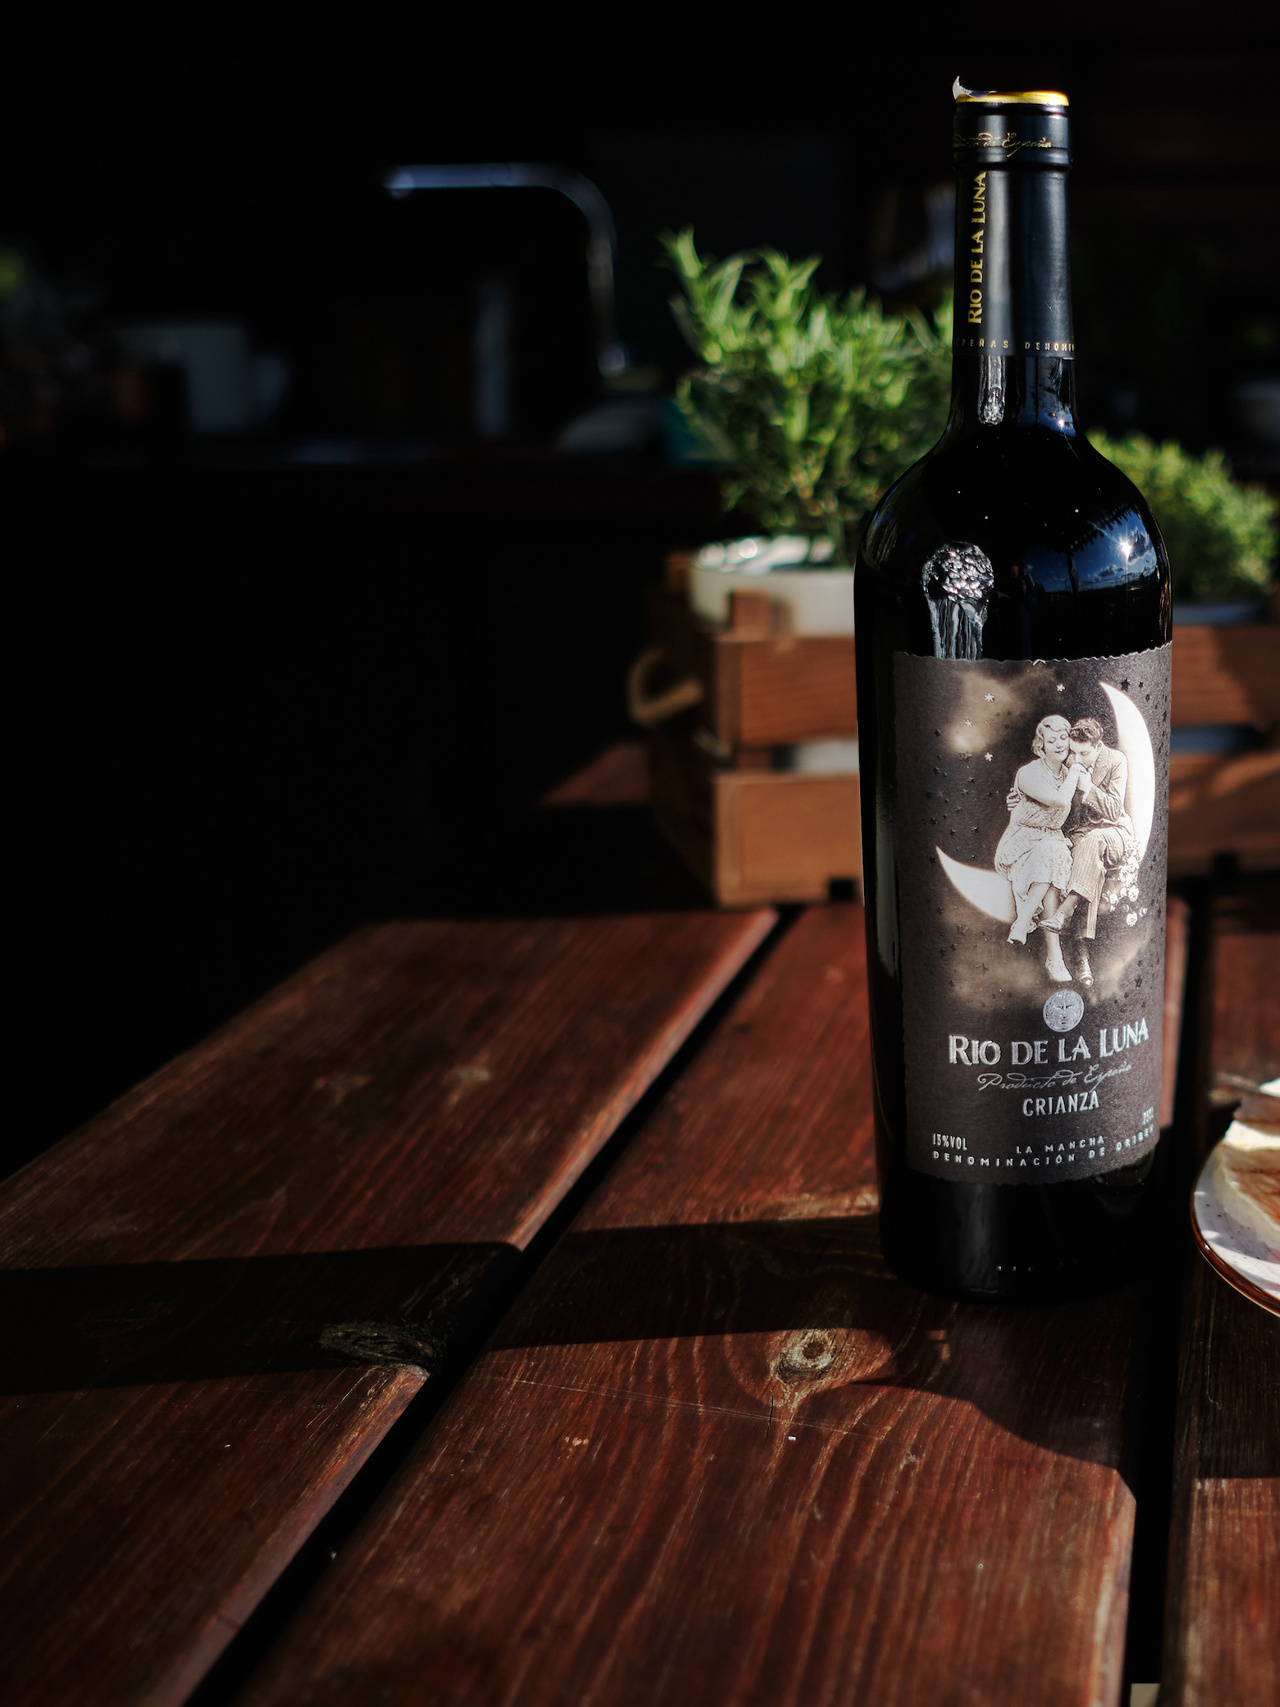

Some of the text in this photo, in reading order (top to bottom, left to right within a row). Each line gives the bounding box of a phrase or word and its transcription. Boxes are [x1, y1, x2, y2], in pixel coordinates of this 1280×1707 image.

[967, 171, 987, 325] RIO DE LA LUNA
[949, 1017, 1150, 1066] RIO DE LA LUNA
[977, 1063, 1133, 1093] Producto de España
[1022, 1090, 1100, 1117] CRIANZA
[933, 1150, 1076, 1168] DENOMINACIÓN
[1088, 1147, 1106, 1159] DE
[1016, 1135, 1105, 1154] LA MANCHA
